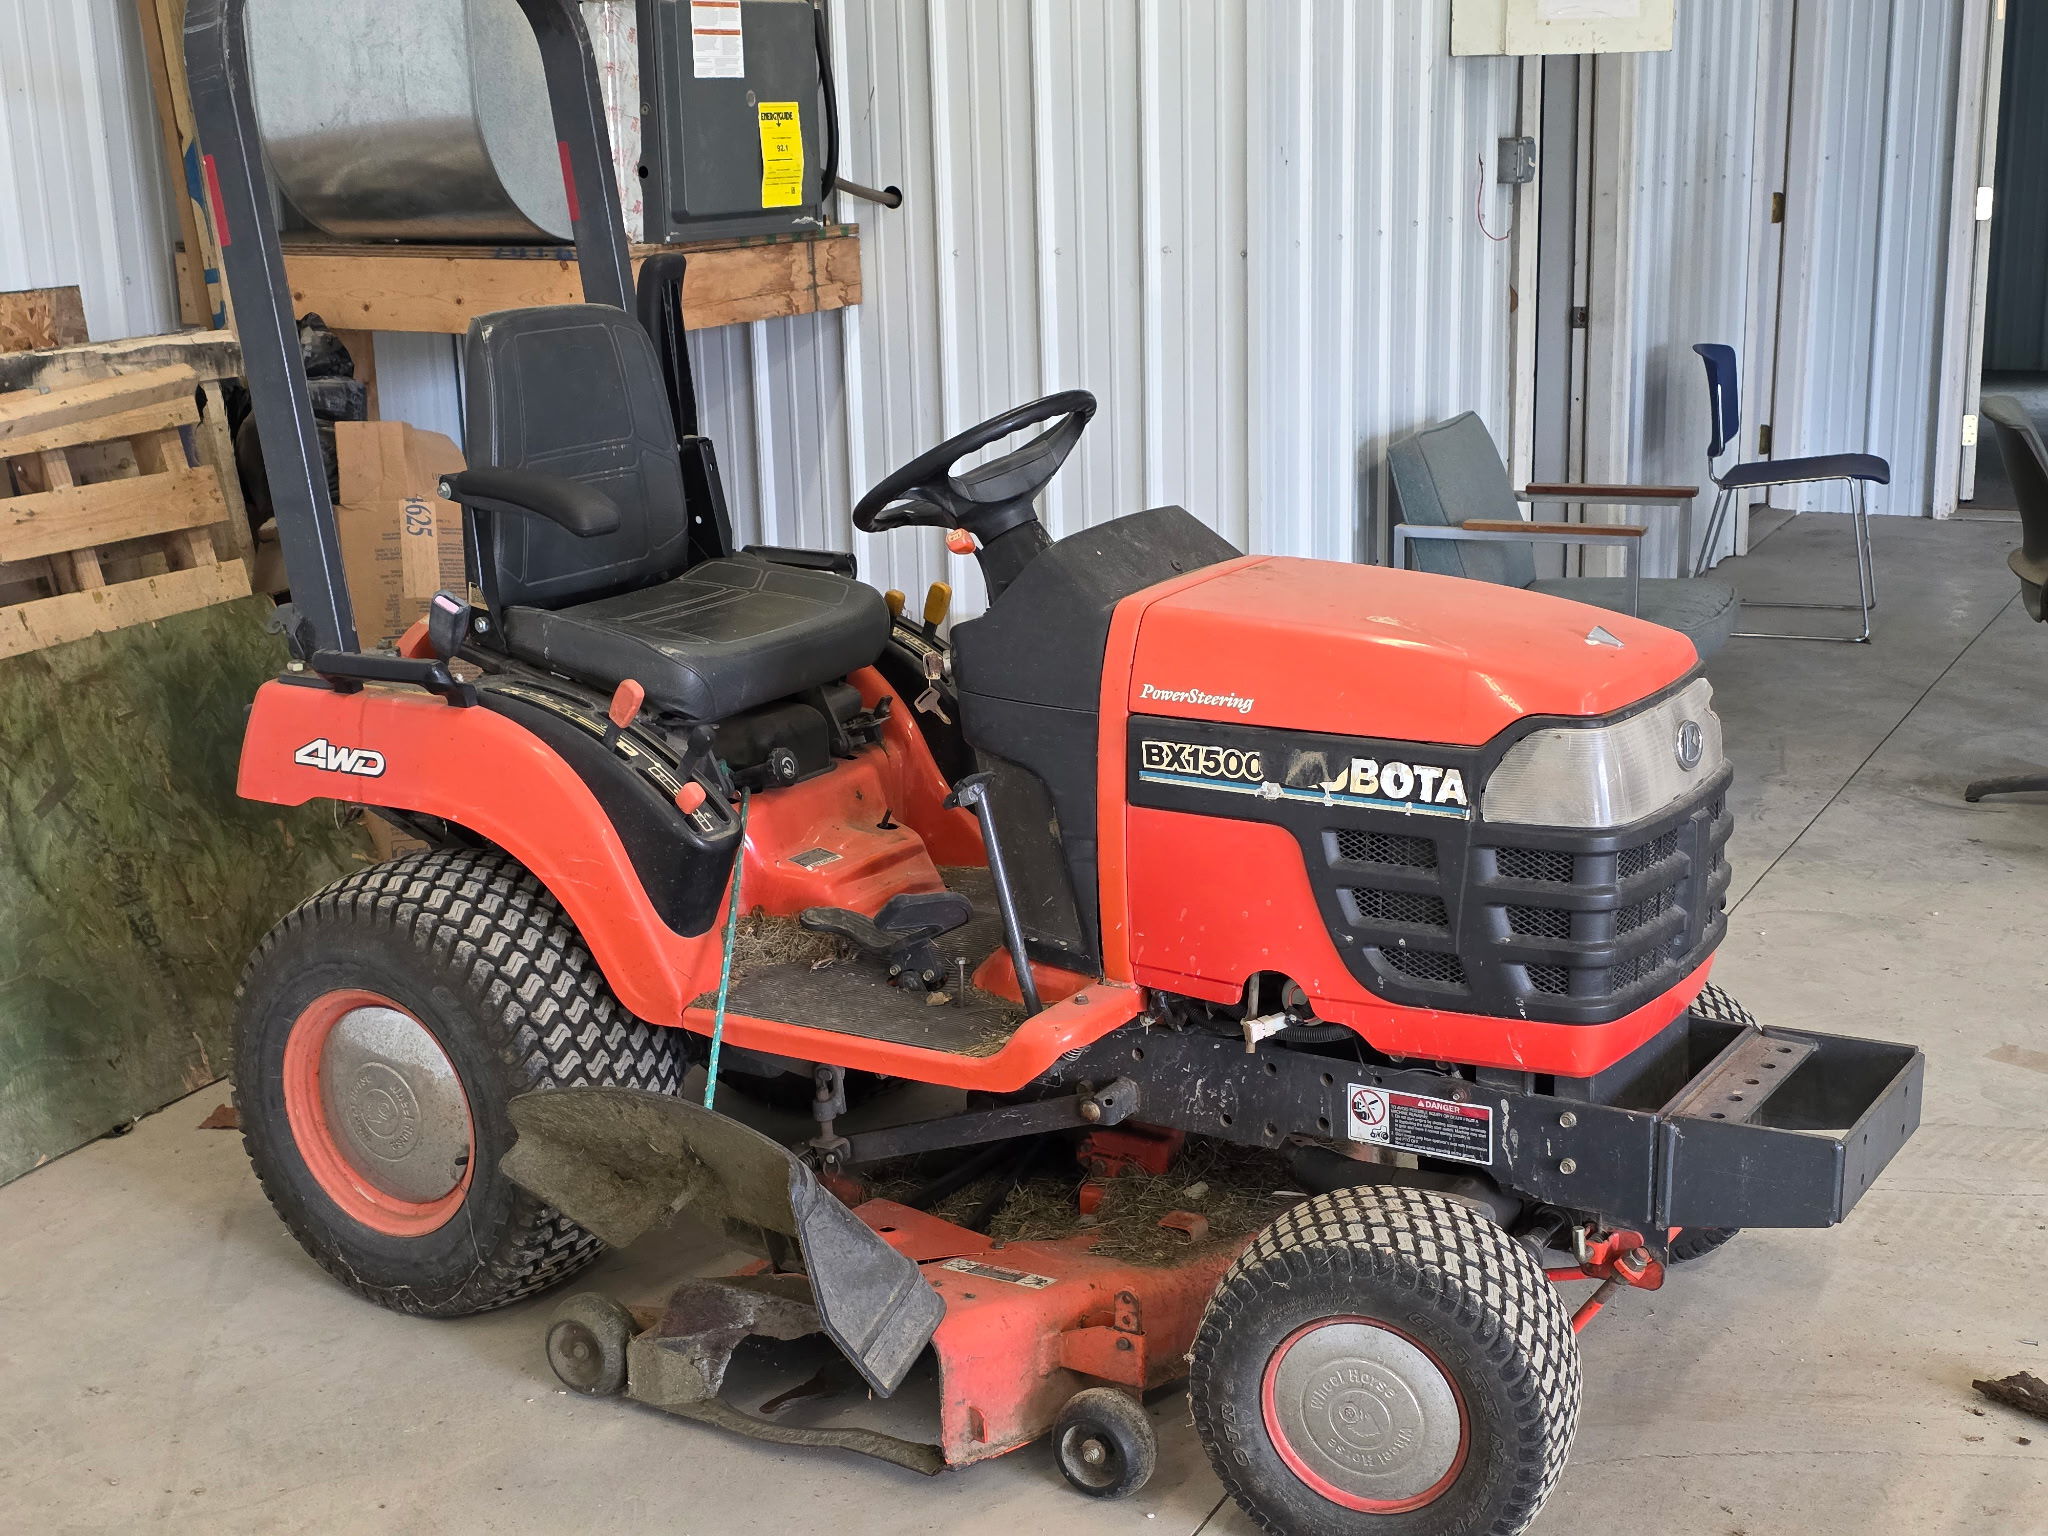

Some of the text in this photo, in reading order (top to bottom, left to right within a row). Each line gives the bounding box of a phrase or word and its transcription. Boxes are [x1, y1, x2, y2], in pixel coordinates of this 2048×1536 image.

[405, 494, 433, 537] 4625
[1140, 683, 1254, 713] PowerSteering
[294, 737, 386, 778] 4WD
[1307, 757, 1468, 806] BOTA
[1425, 1101, 1460, 1114] DANGER
[1311, 1369, 1395, 1410] Wheel Horse
[1221, 1401, 1252, 1468] OTR
